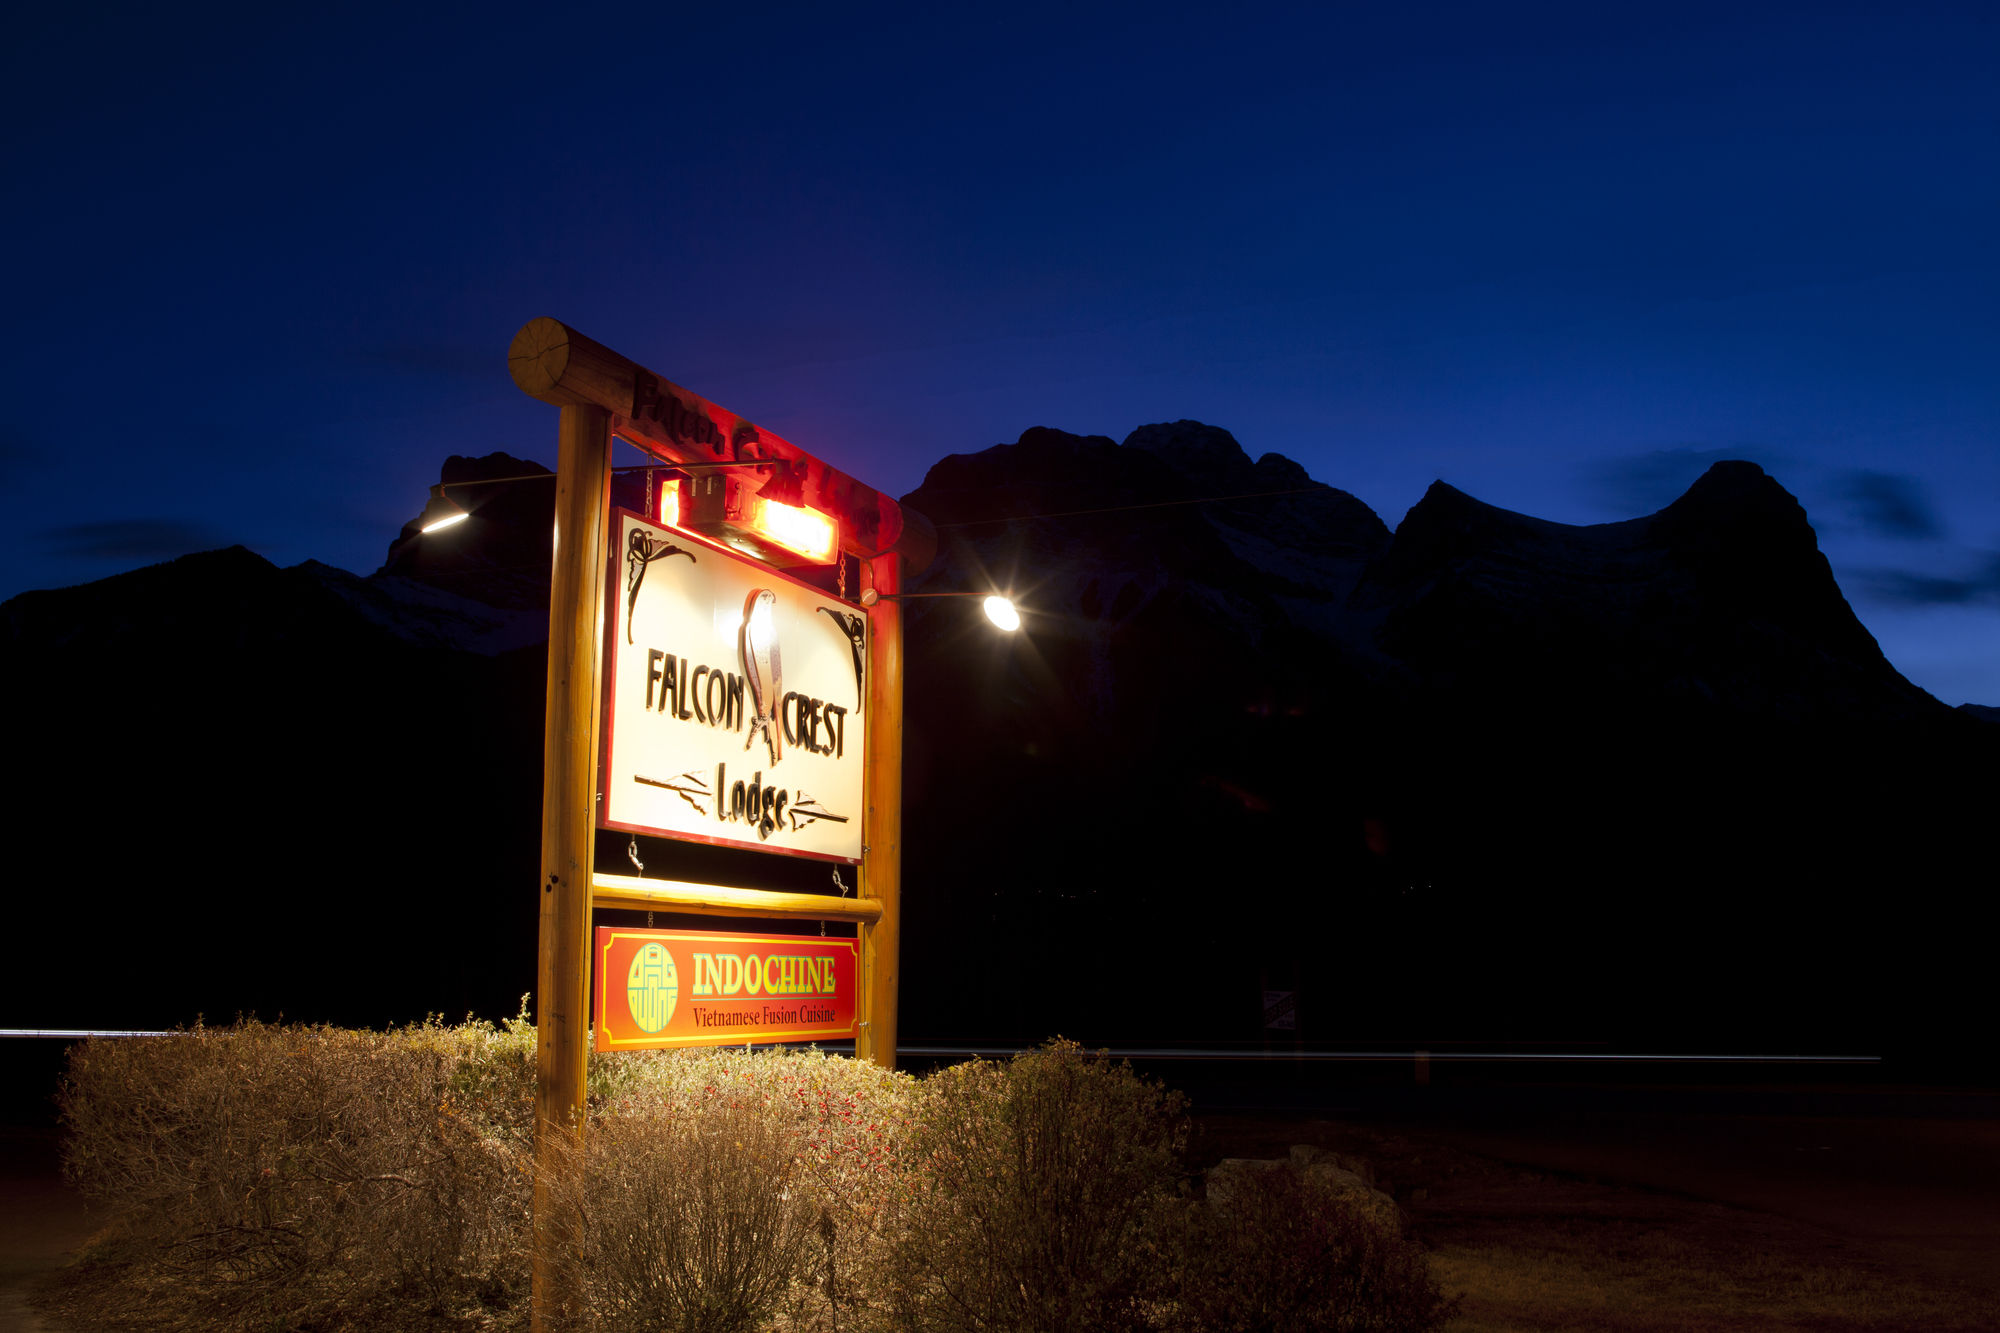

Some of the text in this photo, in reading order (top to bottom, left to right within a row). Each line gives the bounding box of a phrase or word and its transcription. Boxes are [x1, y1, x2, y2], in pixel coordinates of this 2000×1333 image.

[646, 648, 848, 759] FALCON CREST
[717, 762, 788, 840] Lodge
[692, 953, 836, 995] INDOCHINE
[693, 1004, 836, 1028] Vietnamese Fusion Cuisine
